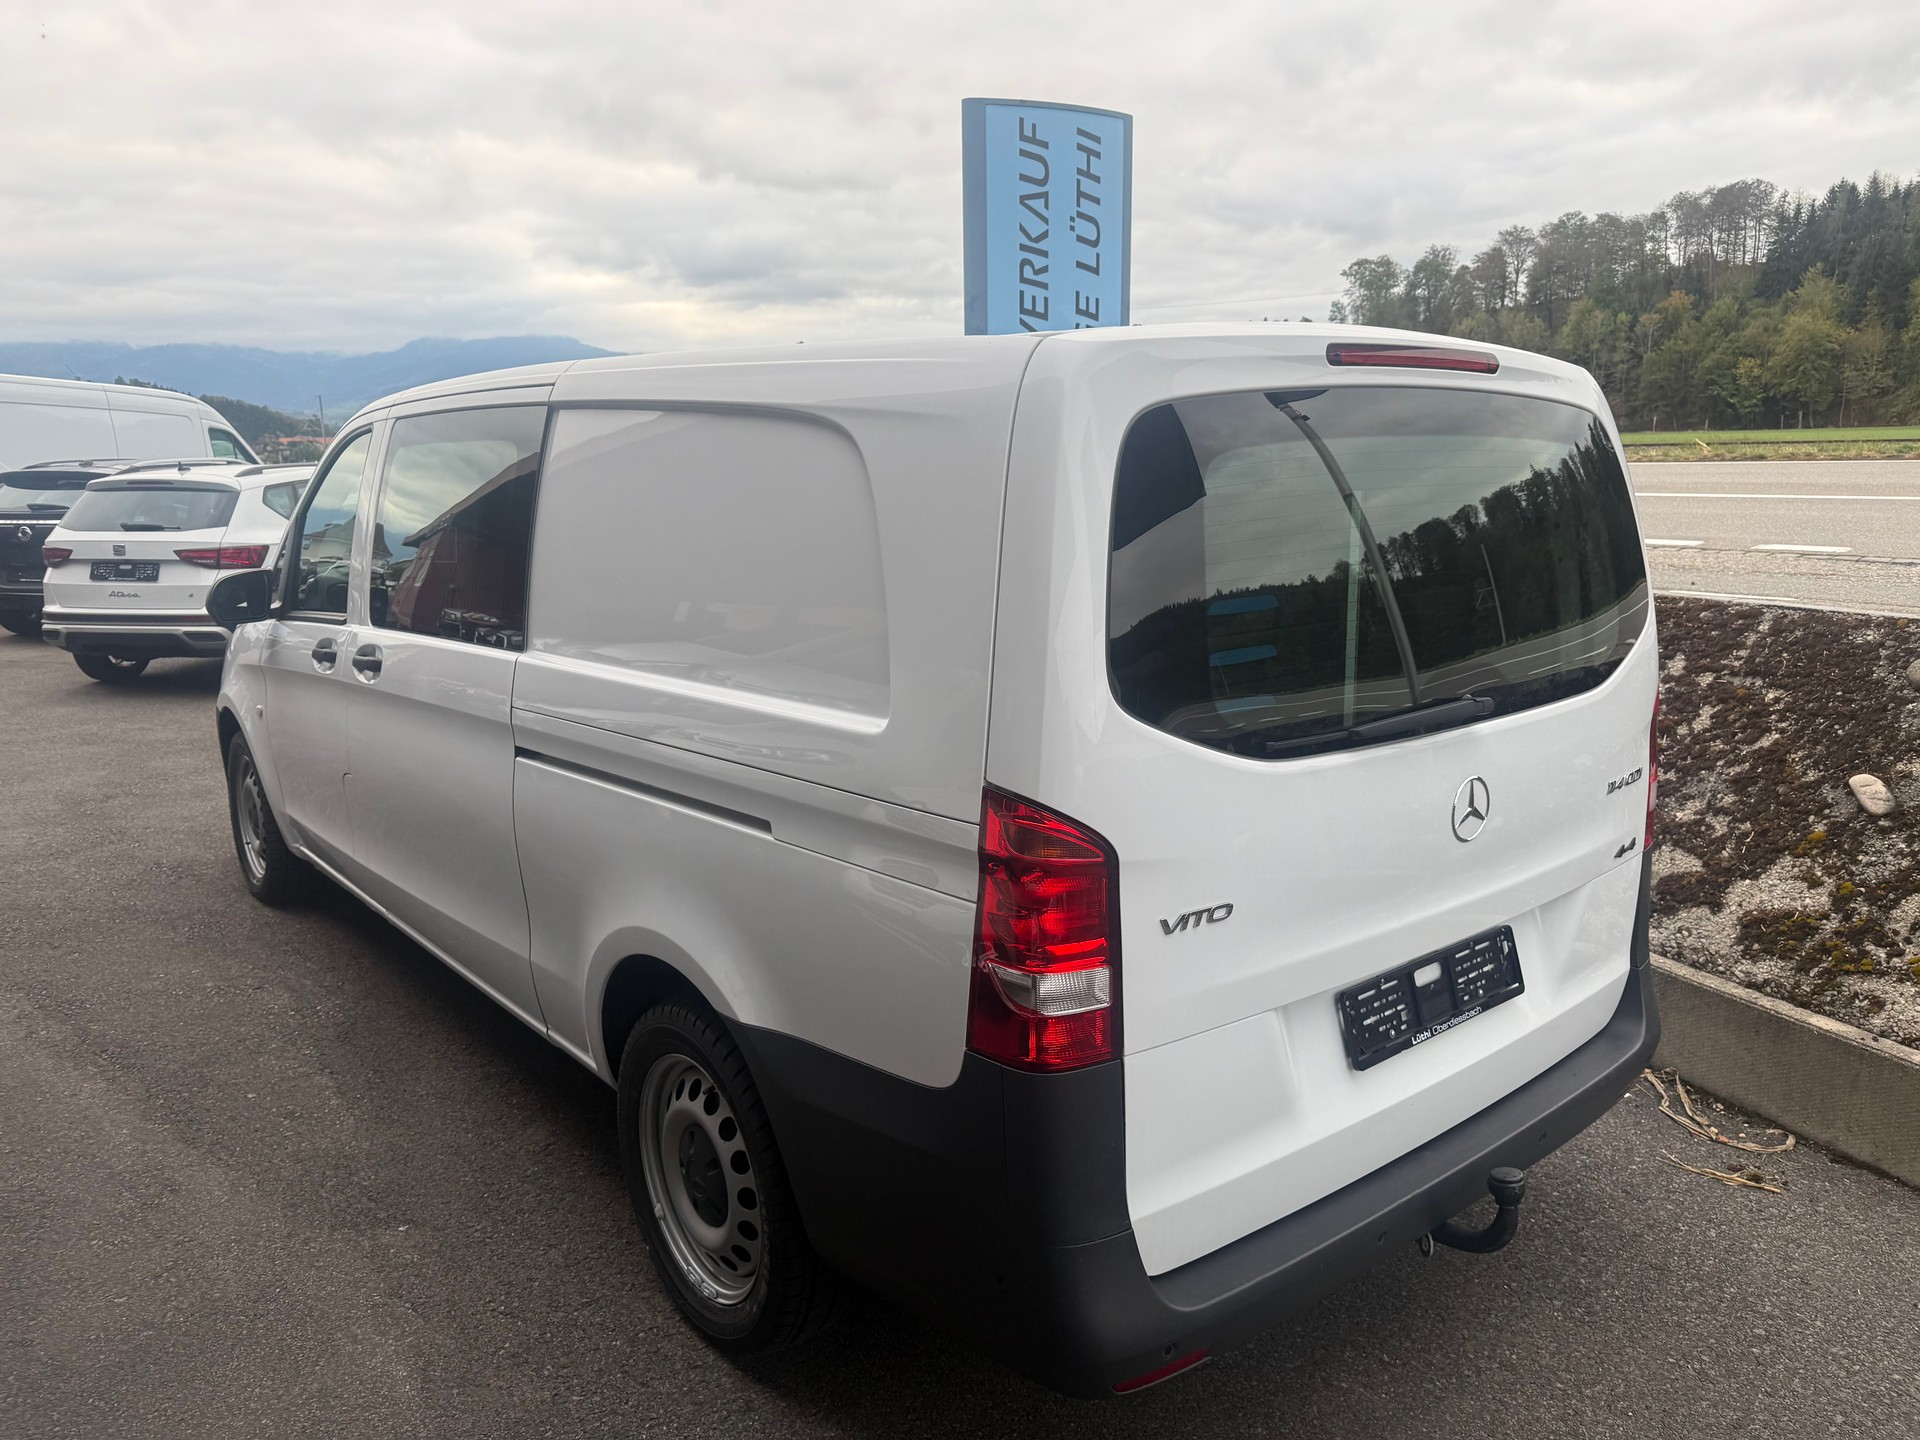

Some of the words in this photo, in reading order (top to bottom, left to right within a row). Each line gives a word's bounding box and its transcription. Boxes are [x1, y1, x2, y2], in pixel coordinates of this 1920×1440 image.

[1069, 126, 1102, 277] LÜTHI
[1159, 902, 1234, 936] VITO
[1411, 1029, 1432, 1045] Lüthi
